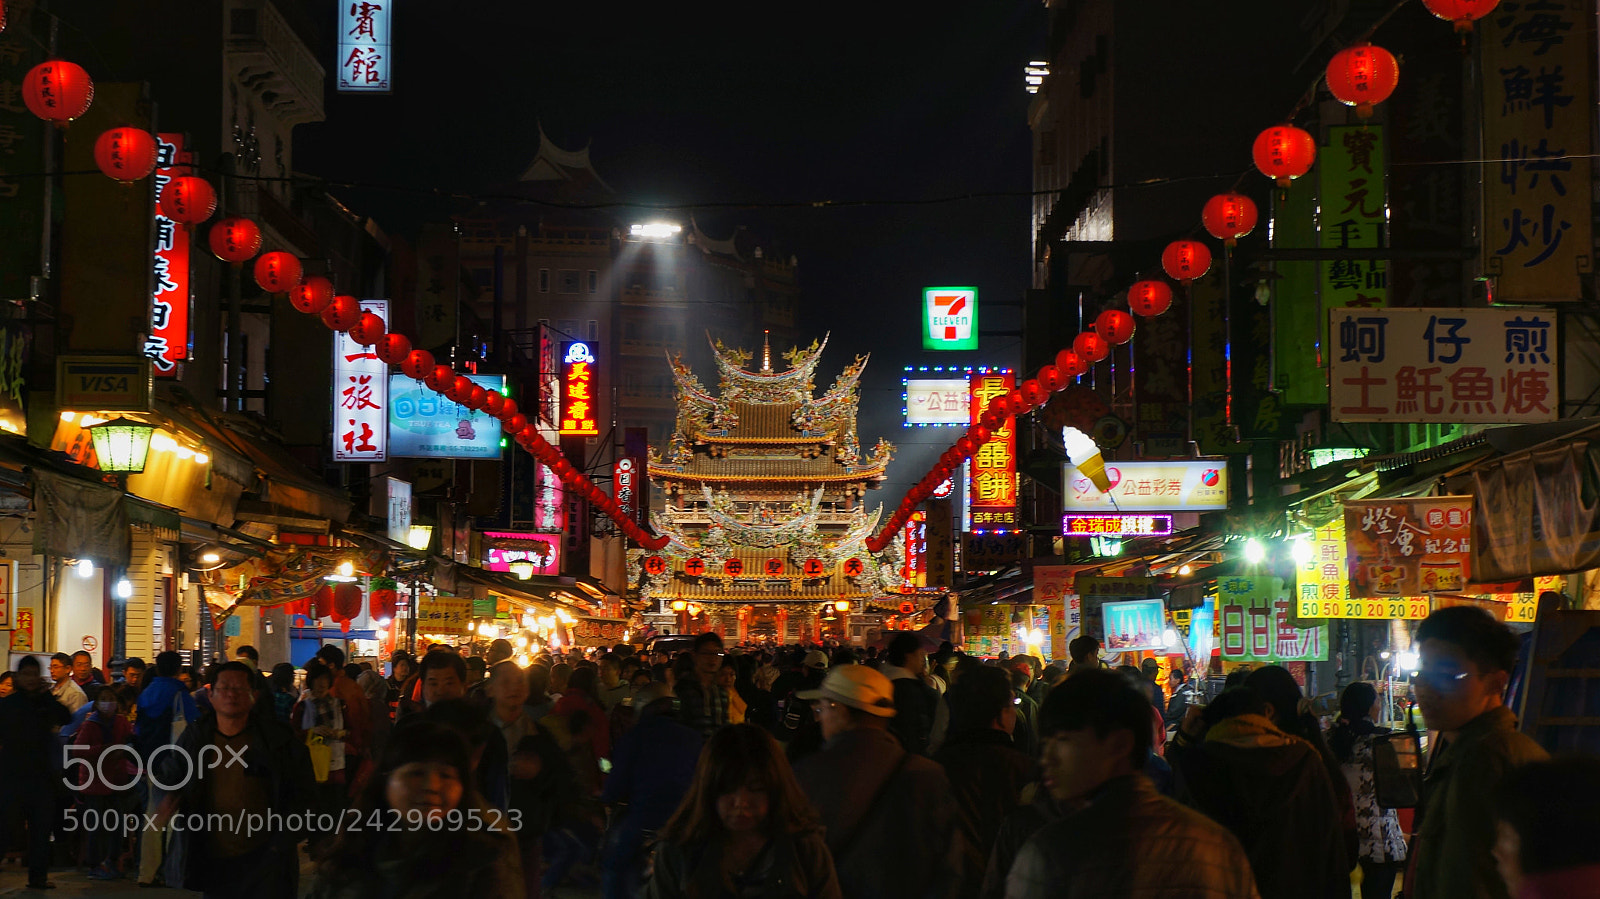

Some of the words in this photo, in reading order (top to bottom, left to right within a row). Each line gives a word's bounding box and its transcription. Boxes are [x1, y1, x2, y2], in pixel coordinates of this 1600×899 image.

[344, 1, 382, 84] 賓館
[1344, 130, 1381, 218] 寶元
[935, 296, 966, 339] 7
[1340, 315, 1551, 364] 蚵仔煎
[81, 376, 129, 392] VISA
[973, 376, 1013, 500] 長囍餅
[1123, 478, 1181, 496] 公益彩券
[973, 512, 1015, 524] 百年老店
[1362, 507, 1430, 556] 燈會
[688, 561, 702, 574] 千
[727, 562, 742, 574] 母
[807, 561, 820, 574] 上
[848, 560, 861, 573] 天
[1302, 603, 1318, 616] 50
[1323, 603, 1339, 616] 50
[1345, 604, 1362, 617] 20
[1367, 604, 1384, 617] 20
[1389, 604, 1405, 617] 20
[1410, 605, 1427, 617] 20
[1519, 606, 1535, 619] 40
